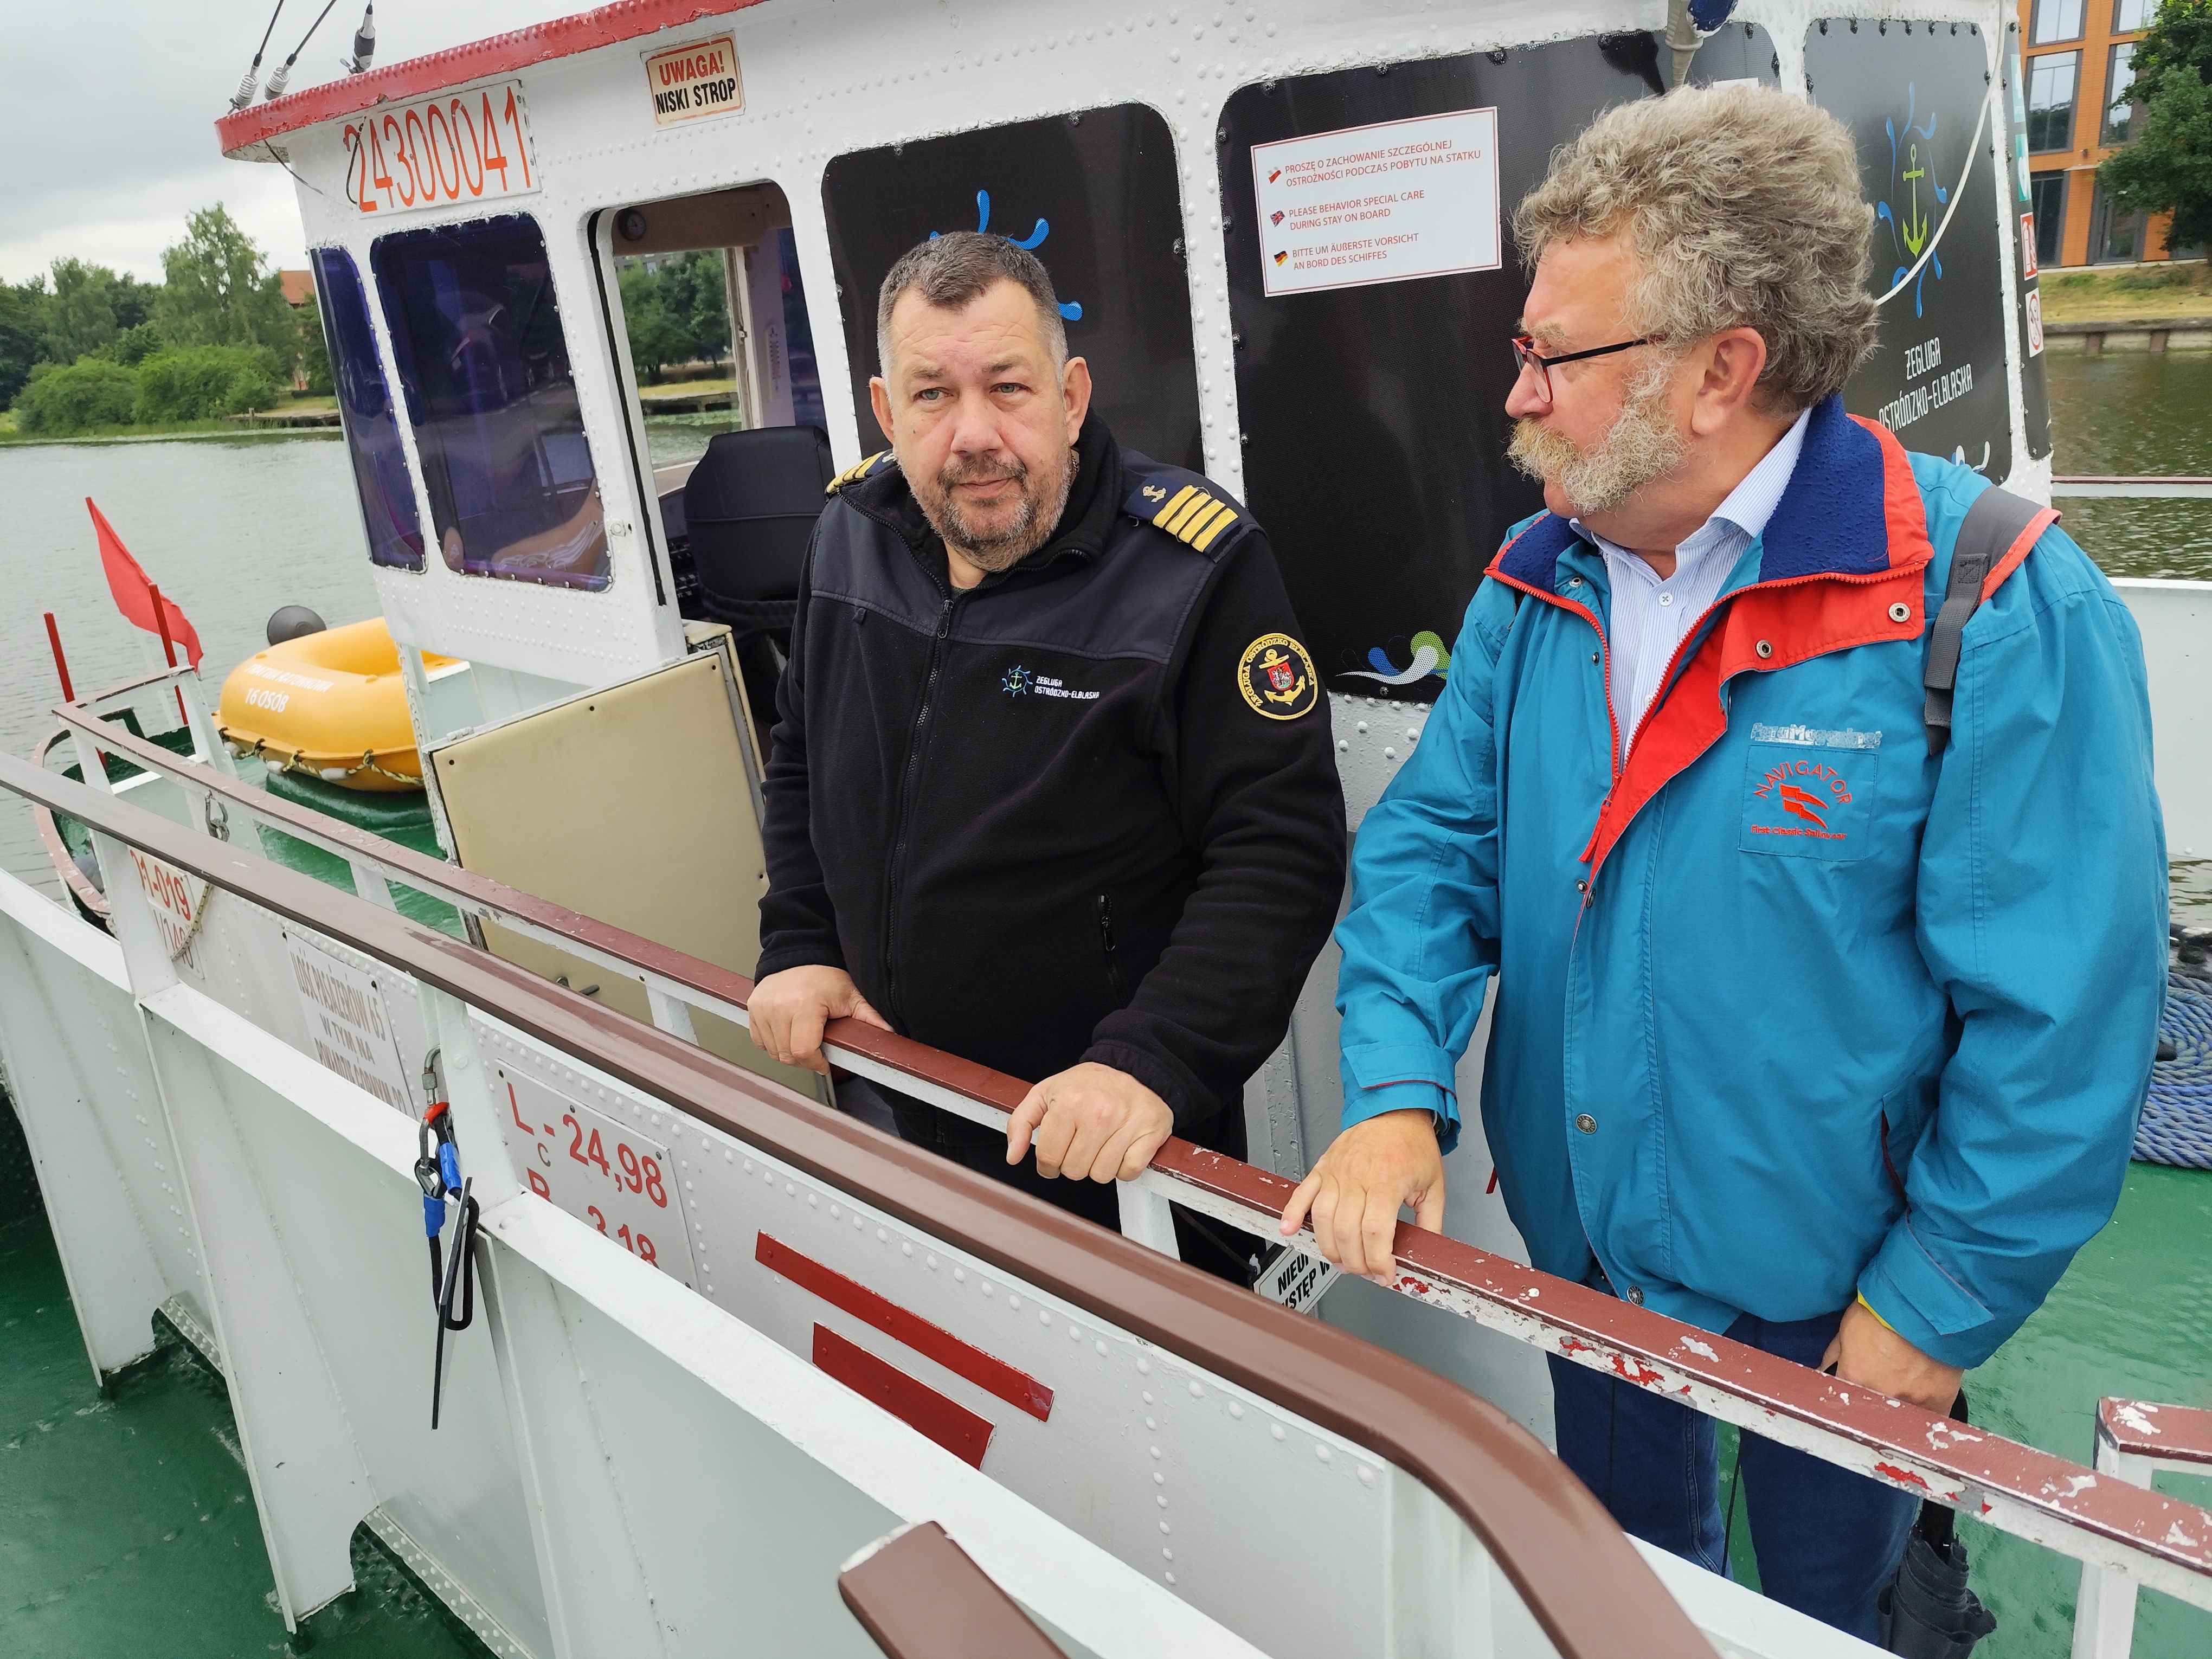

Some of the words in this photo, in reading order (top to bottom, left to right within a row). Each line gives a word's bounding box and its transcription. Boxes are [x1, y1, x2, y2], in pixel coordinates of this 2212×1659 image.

[659, 50, 725, 86] UWAGA!
[655, 88, 690, 114] NISKI
[693, 78, 736, 107] STROP
[343, 85, 531, 213] 24300041
[1285, 161, 1316, 174] PROSZĘ
[1317, 160, 1324, 169] O
[1326, 150, 1385, 167] ZACHOWANIE
[1387, 140, 1452, 157] SZCZEGÓLNEJ
[1286, 170, 1343, 187] OSTROŻNOŚCI
[1346, 163, 1388, 177] PODCZAS
[1391, 157, 1427, 170] POBYTU
[1430, 155, 1444, 165] NA
[1446, 150, 1481, 163] STATKU
[1289, 205, 1317, 217] PLEASE
[1319, 199, 1361, 213] BEHAVIOR
[1364, 194, 1399, 207] SPECIAL
[1400, 190, 1425, 201] CARE
[1290, 218, 1321, 230] DURING
[1323, 215, 1342, 226] STAY
[1345, 213, 1358, 222] ON
[1360, 208, 1391, 220] BOARD
[1293, 247, 1314, 258] BITTE
[1315, 245, 1329, 255] UM
[1374, 233, 1419, 246] VORSICHT
[1294, 262, 1305, 270] AN
[1307, 258, 1329, 269] BORD
[1331, 256, 1347, 266] DES
[1348, 250, 1387, 262] SCHIFFES
[245, 687, 260, 705] 16
[258, 690, 290, 713] OSÓB
[1753, 760, 1853, 804] NAVIGATOR
